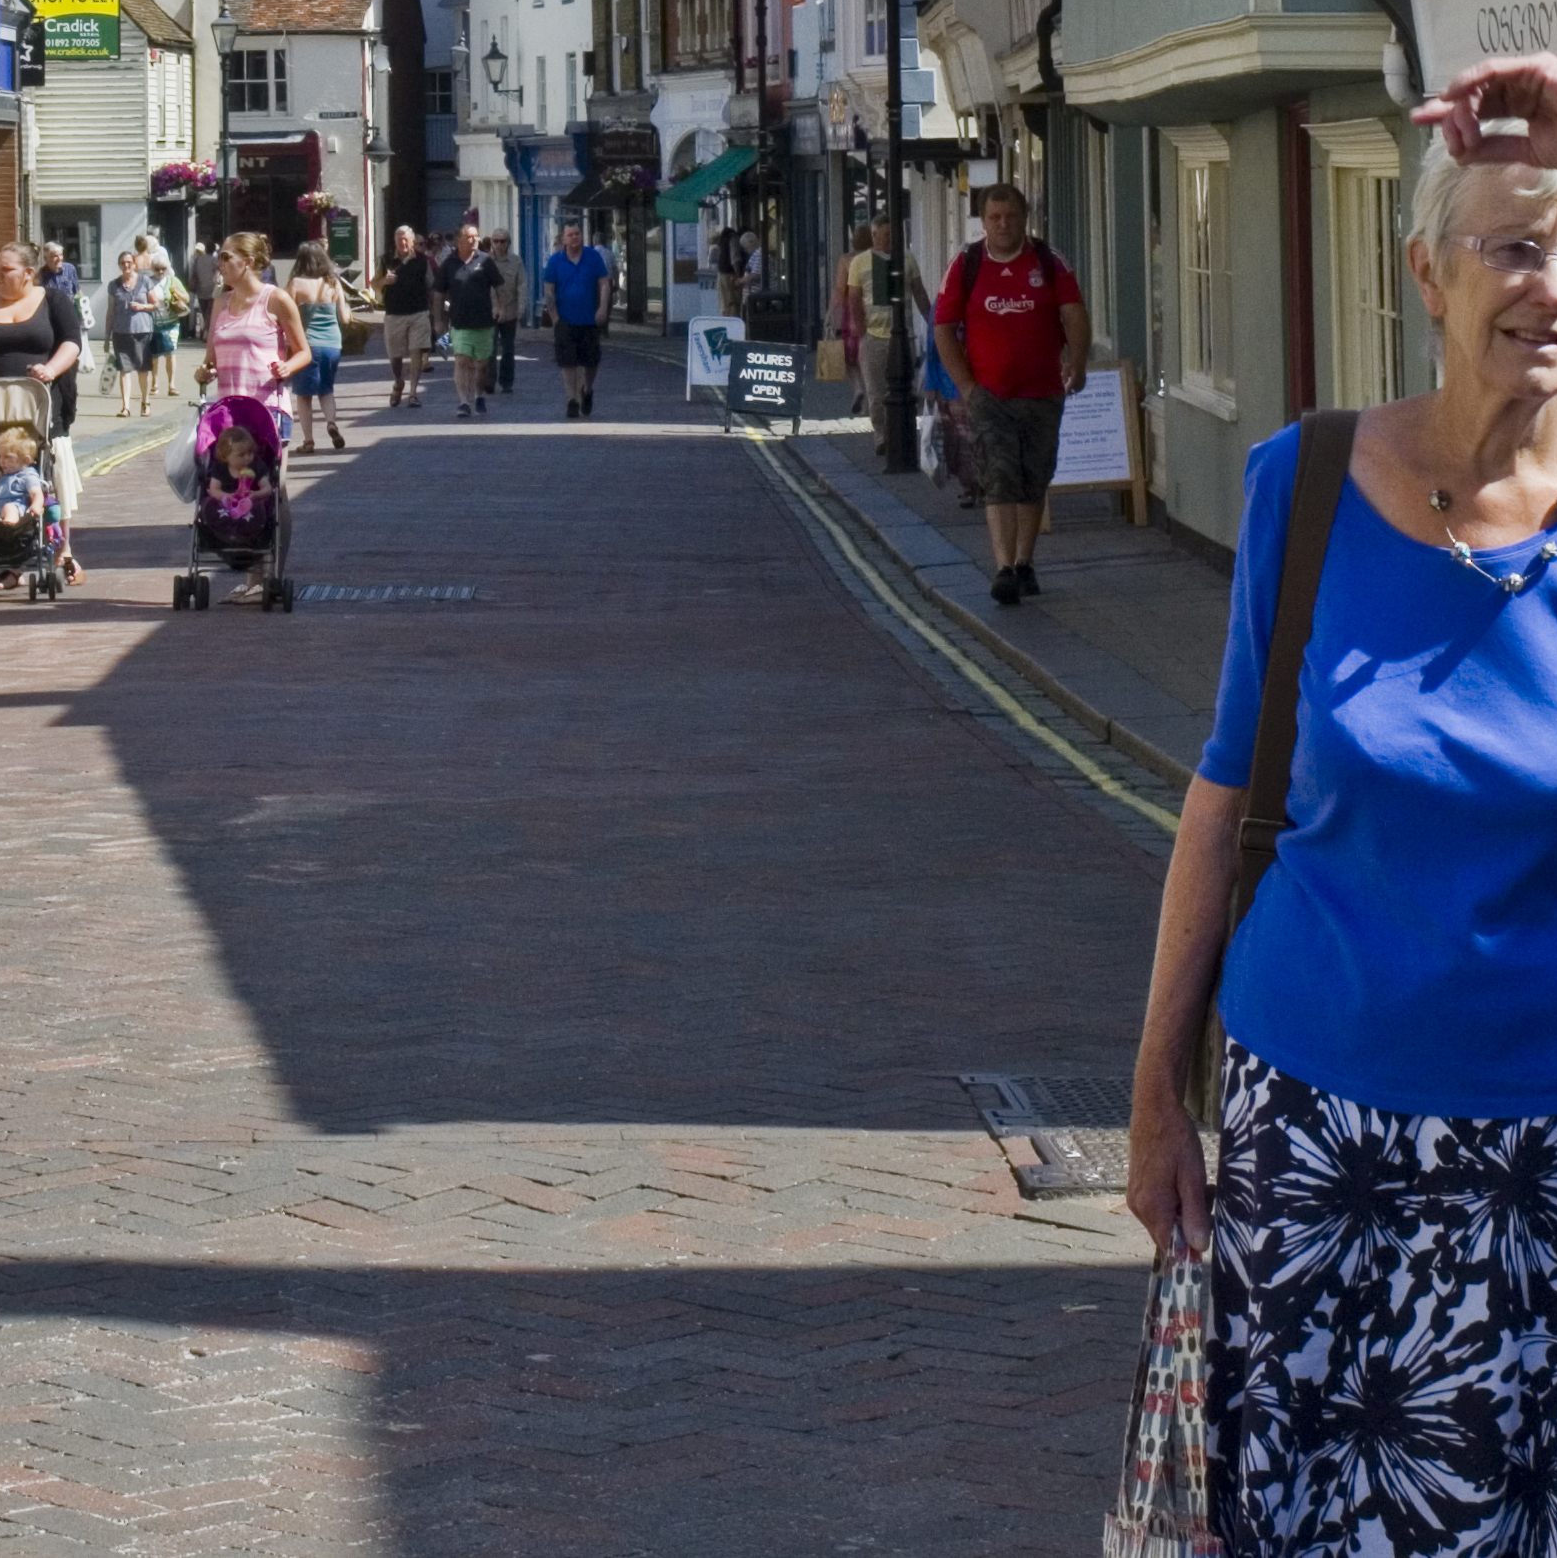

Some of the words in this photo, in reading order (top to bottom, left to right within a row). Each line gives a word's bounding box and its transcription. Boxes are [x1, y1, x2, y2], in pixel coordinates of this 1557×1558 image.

[44, 18, 100, 33] Cradick
[45, 38, 70, 48] 01892
[71, 38, 101, 48] 707505
[984, 293, 1035, 314] Carlsberg
[746, 352, 793, 367] SQUIRES
[739, 367, 796, 384] ANTIQUES
[752, 384, 782, 396] OPEN
